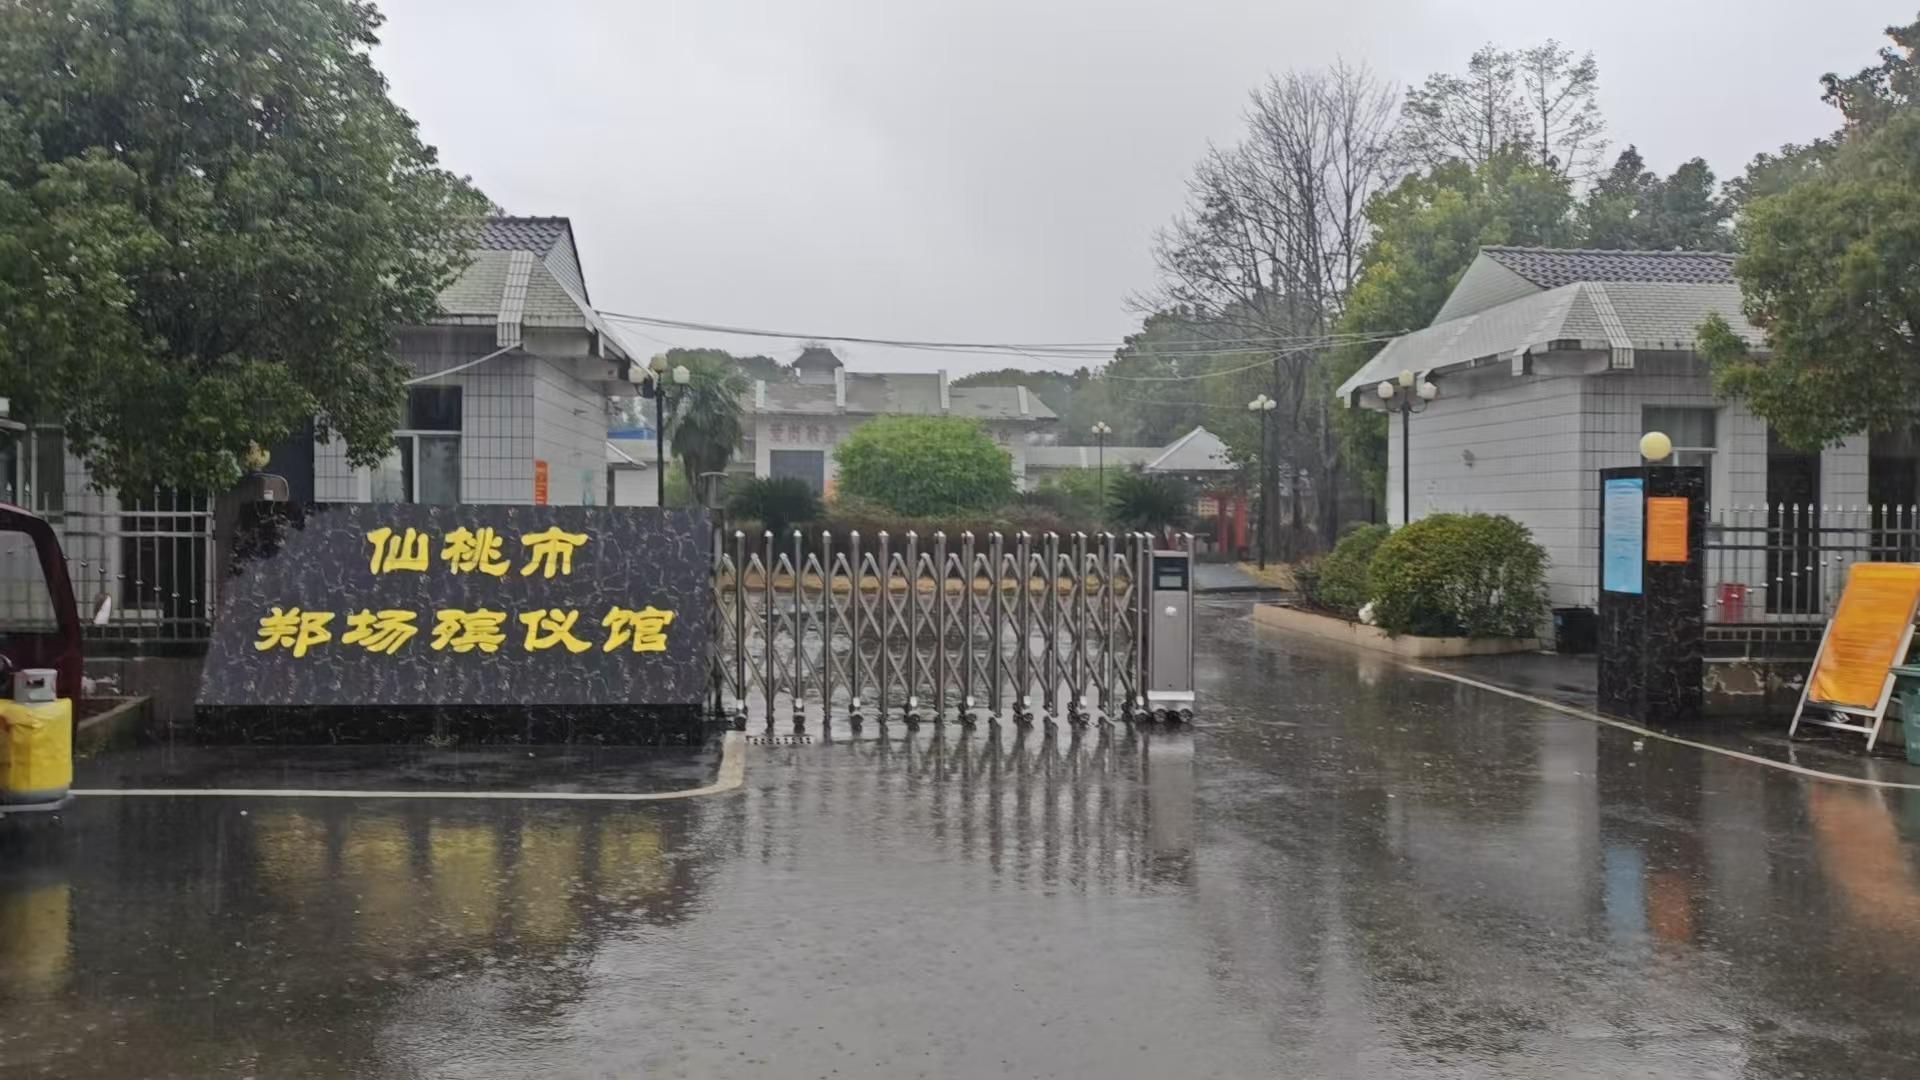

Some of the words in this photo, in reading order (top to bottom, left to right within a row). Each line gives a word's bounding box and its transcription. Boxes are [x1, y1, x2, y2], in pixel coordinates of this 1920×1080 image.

[367, 527, 588, 578] 仙桃市
[254, 606, 673, 658] 郑场殡仪馆
